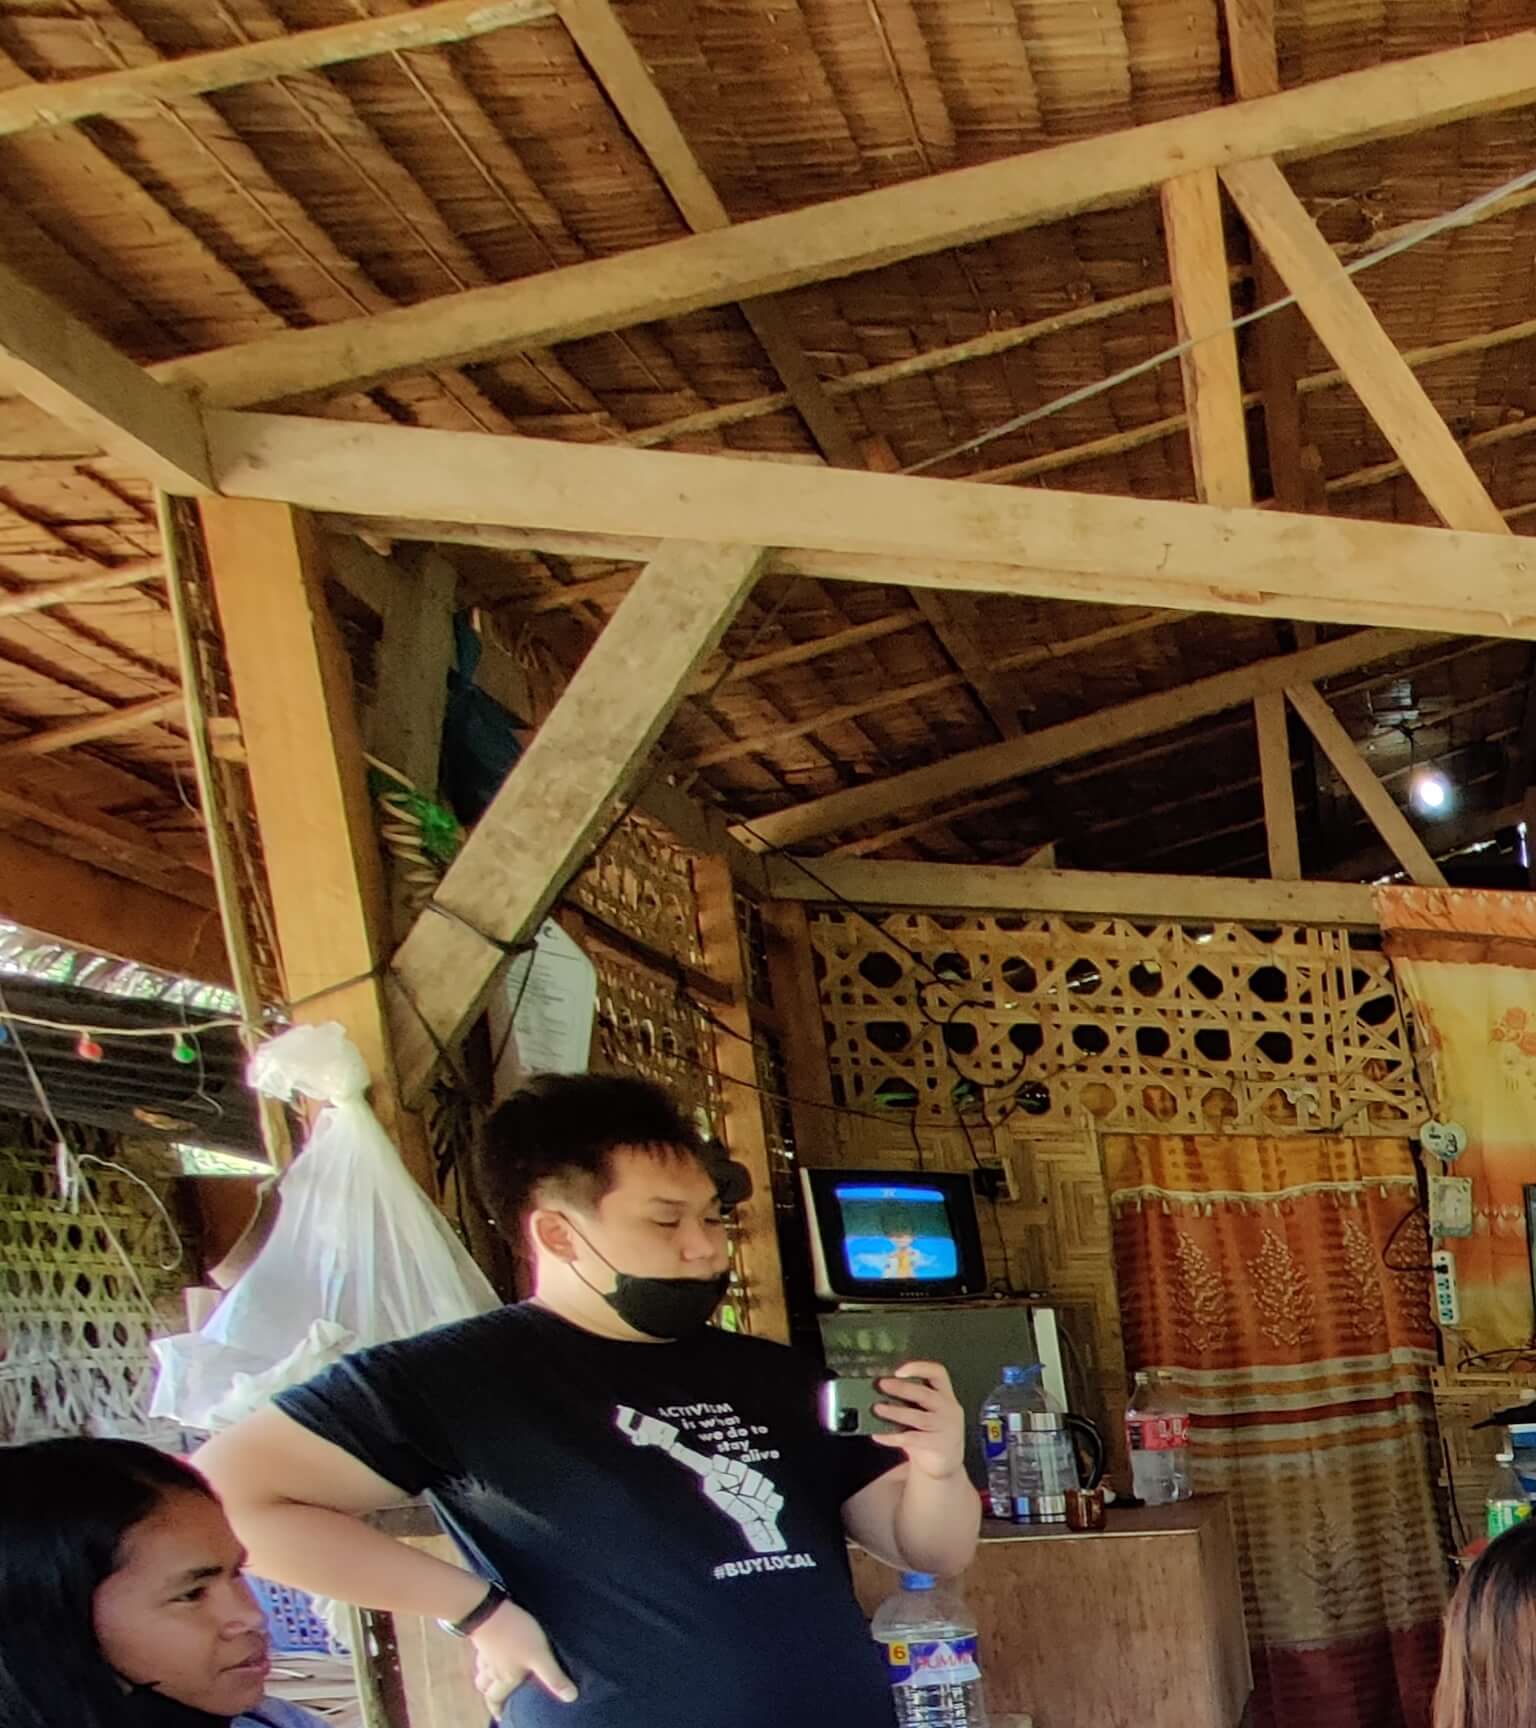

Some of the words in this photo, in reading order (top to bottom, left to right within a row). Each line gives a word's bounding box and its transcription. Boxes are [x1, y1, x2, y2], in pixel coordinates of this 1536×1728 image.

[698, 1430, 724, 1442] we
[726, 1426, 749, 1439] do
[752, 1425, 769, 1435] to
[717, 1440, 750, 1453] stay
[740, 1449, 780, 1463] alive
[713, 1553, 817, 1579] #BUYLOCAL
[893, 1646, 906, 1660] 6
